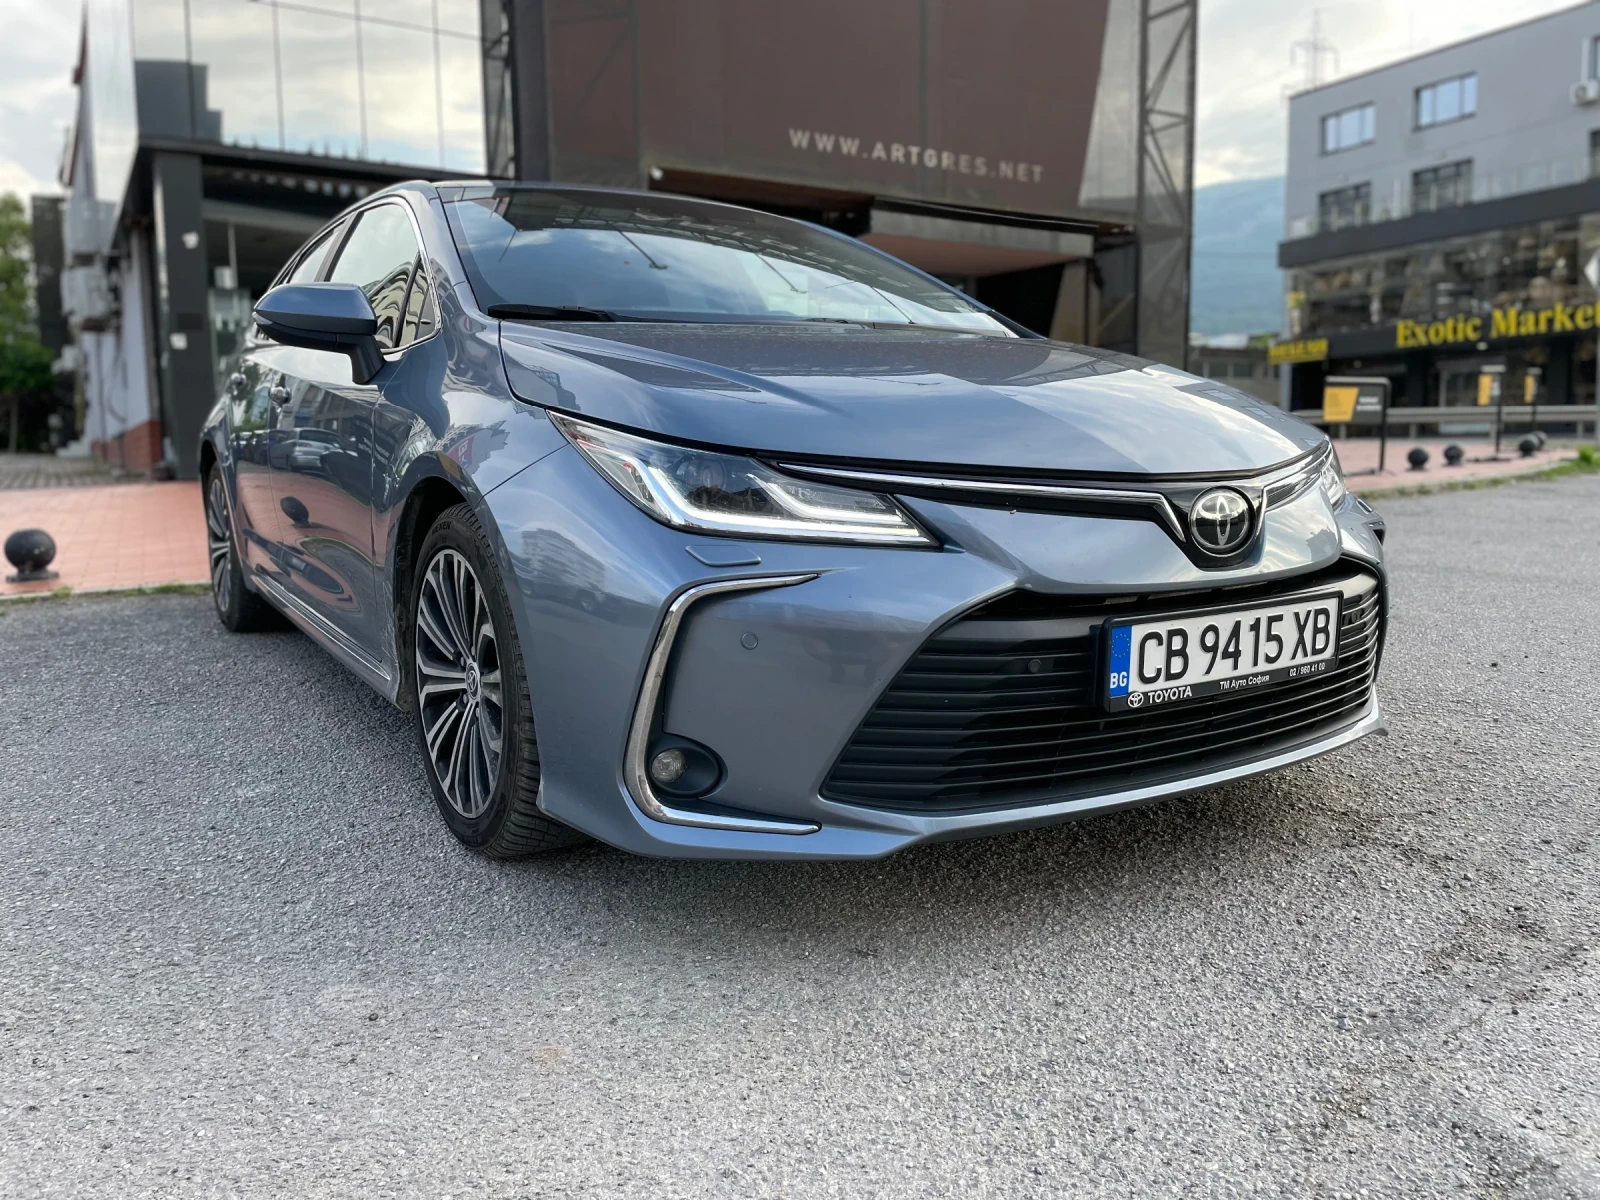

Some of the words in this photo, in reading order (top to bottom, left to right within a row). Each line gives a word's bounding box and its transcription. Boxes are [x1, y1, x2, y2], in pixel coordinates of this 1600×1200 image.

[788, 128, 1044, 182] WWW.ARTGRES.NET
[1396, 314, 1482, 348] Exotic
[1138, 627, 1190, 685] CB
[1200, 613, 1284, 676] 9415
[1291, 607, 1331, 661] XB
[1289, 668, 1297, 677] 02
[1311, 664, 1319, 673] 41
[1319, 662, 1326, 671] 00
[1110, 671, 1128, 689] BG
[1231, 678, 1246, 689] Ауто
[1247, 675, 1270, 686] София
[1148, 685, 1193, 704] TOYOTA
